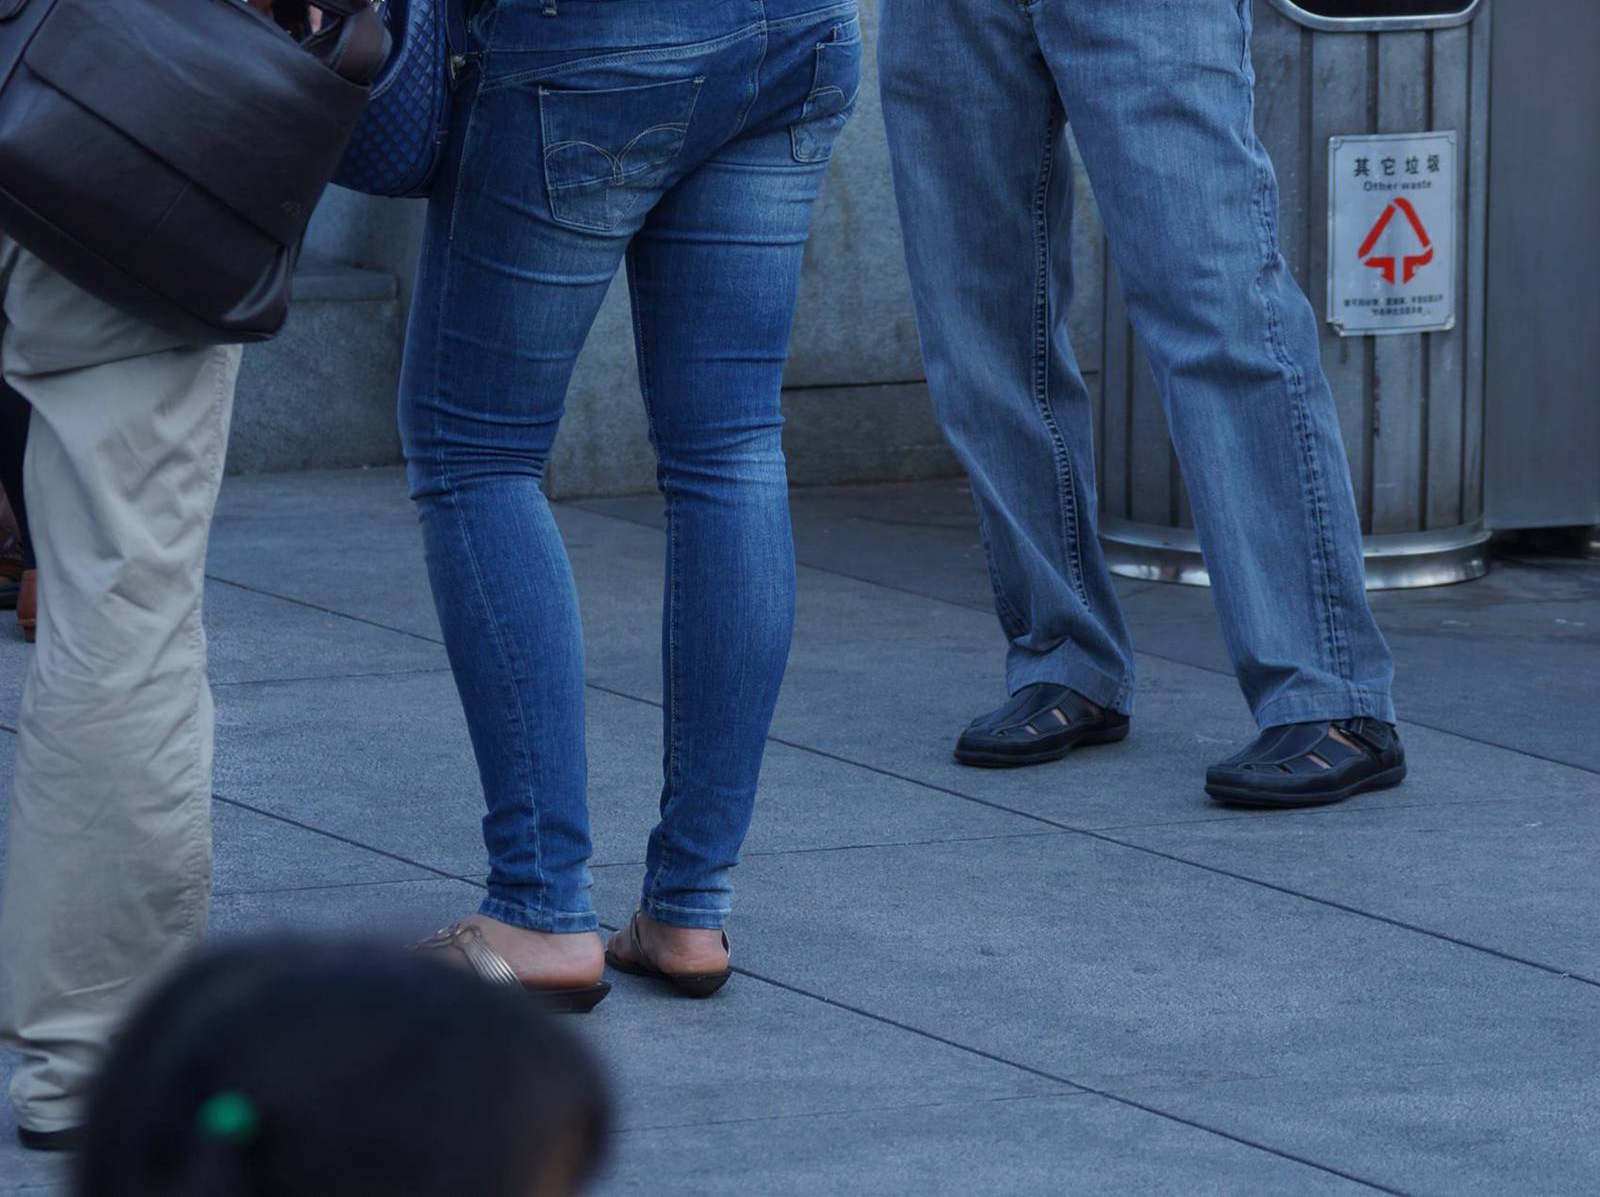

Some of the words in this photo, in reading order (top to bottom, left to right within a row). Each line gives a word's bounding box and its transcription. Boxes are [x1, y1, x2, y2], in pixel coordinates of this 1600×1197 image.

[1353, 154, 1440, 177] 其它垃圾
[1363, 181, 1398, 192] Other
[1401, 180, 1432, 190] waste
